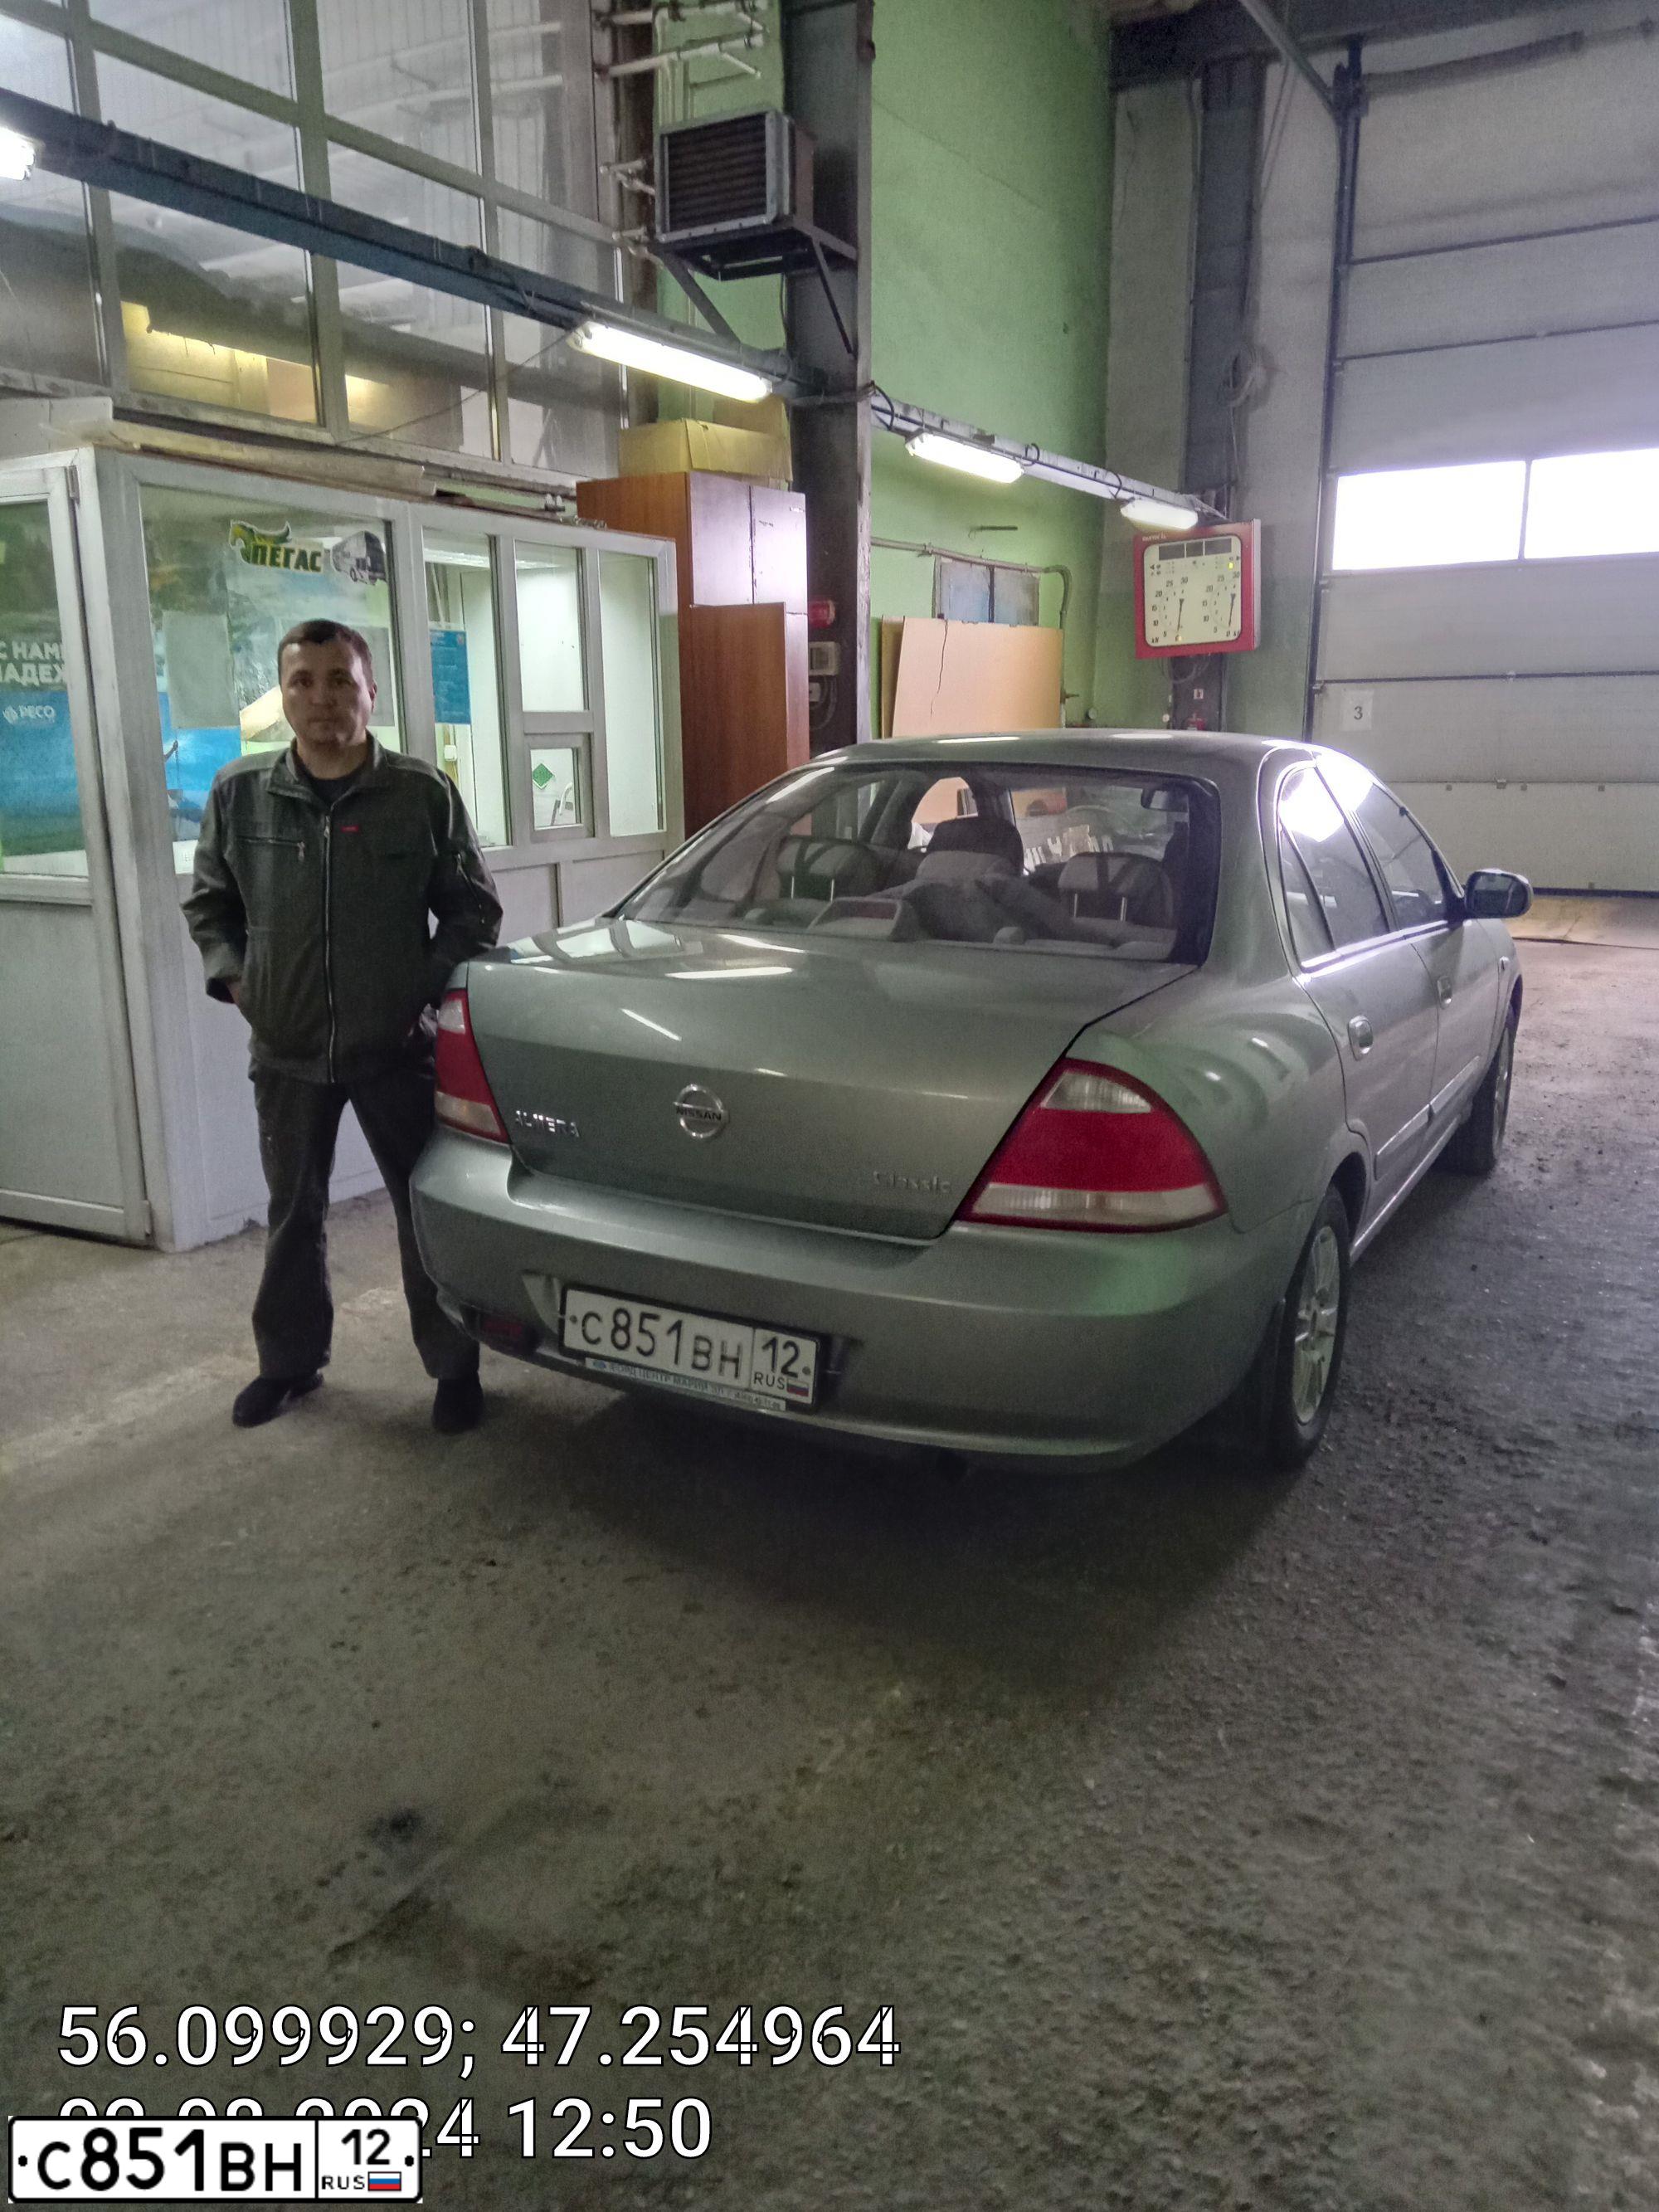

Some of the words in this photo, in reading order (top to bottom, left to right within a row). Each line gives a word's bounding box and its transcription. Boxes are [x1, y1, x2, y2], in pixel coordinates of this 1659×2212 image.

[251, 543, 322, 572] ПЕГАС
[12, 641, 66, 660] НАМ
[1354, 705, 1363, 720] 3
[675, 1105, 722, 1121] NISSAN
[761, 1336, 800, 1378] 12
[753, 1372, 786, 1391] RUS
